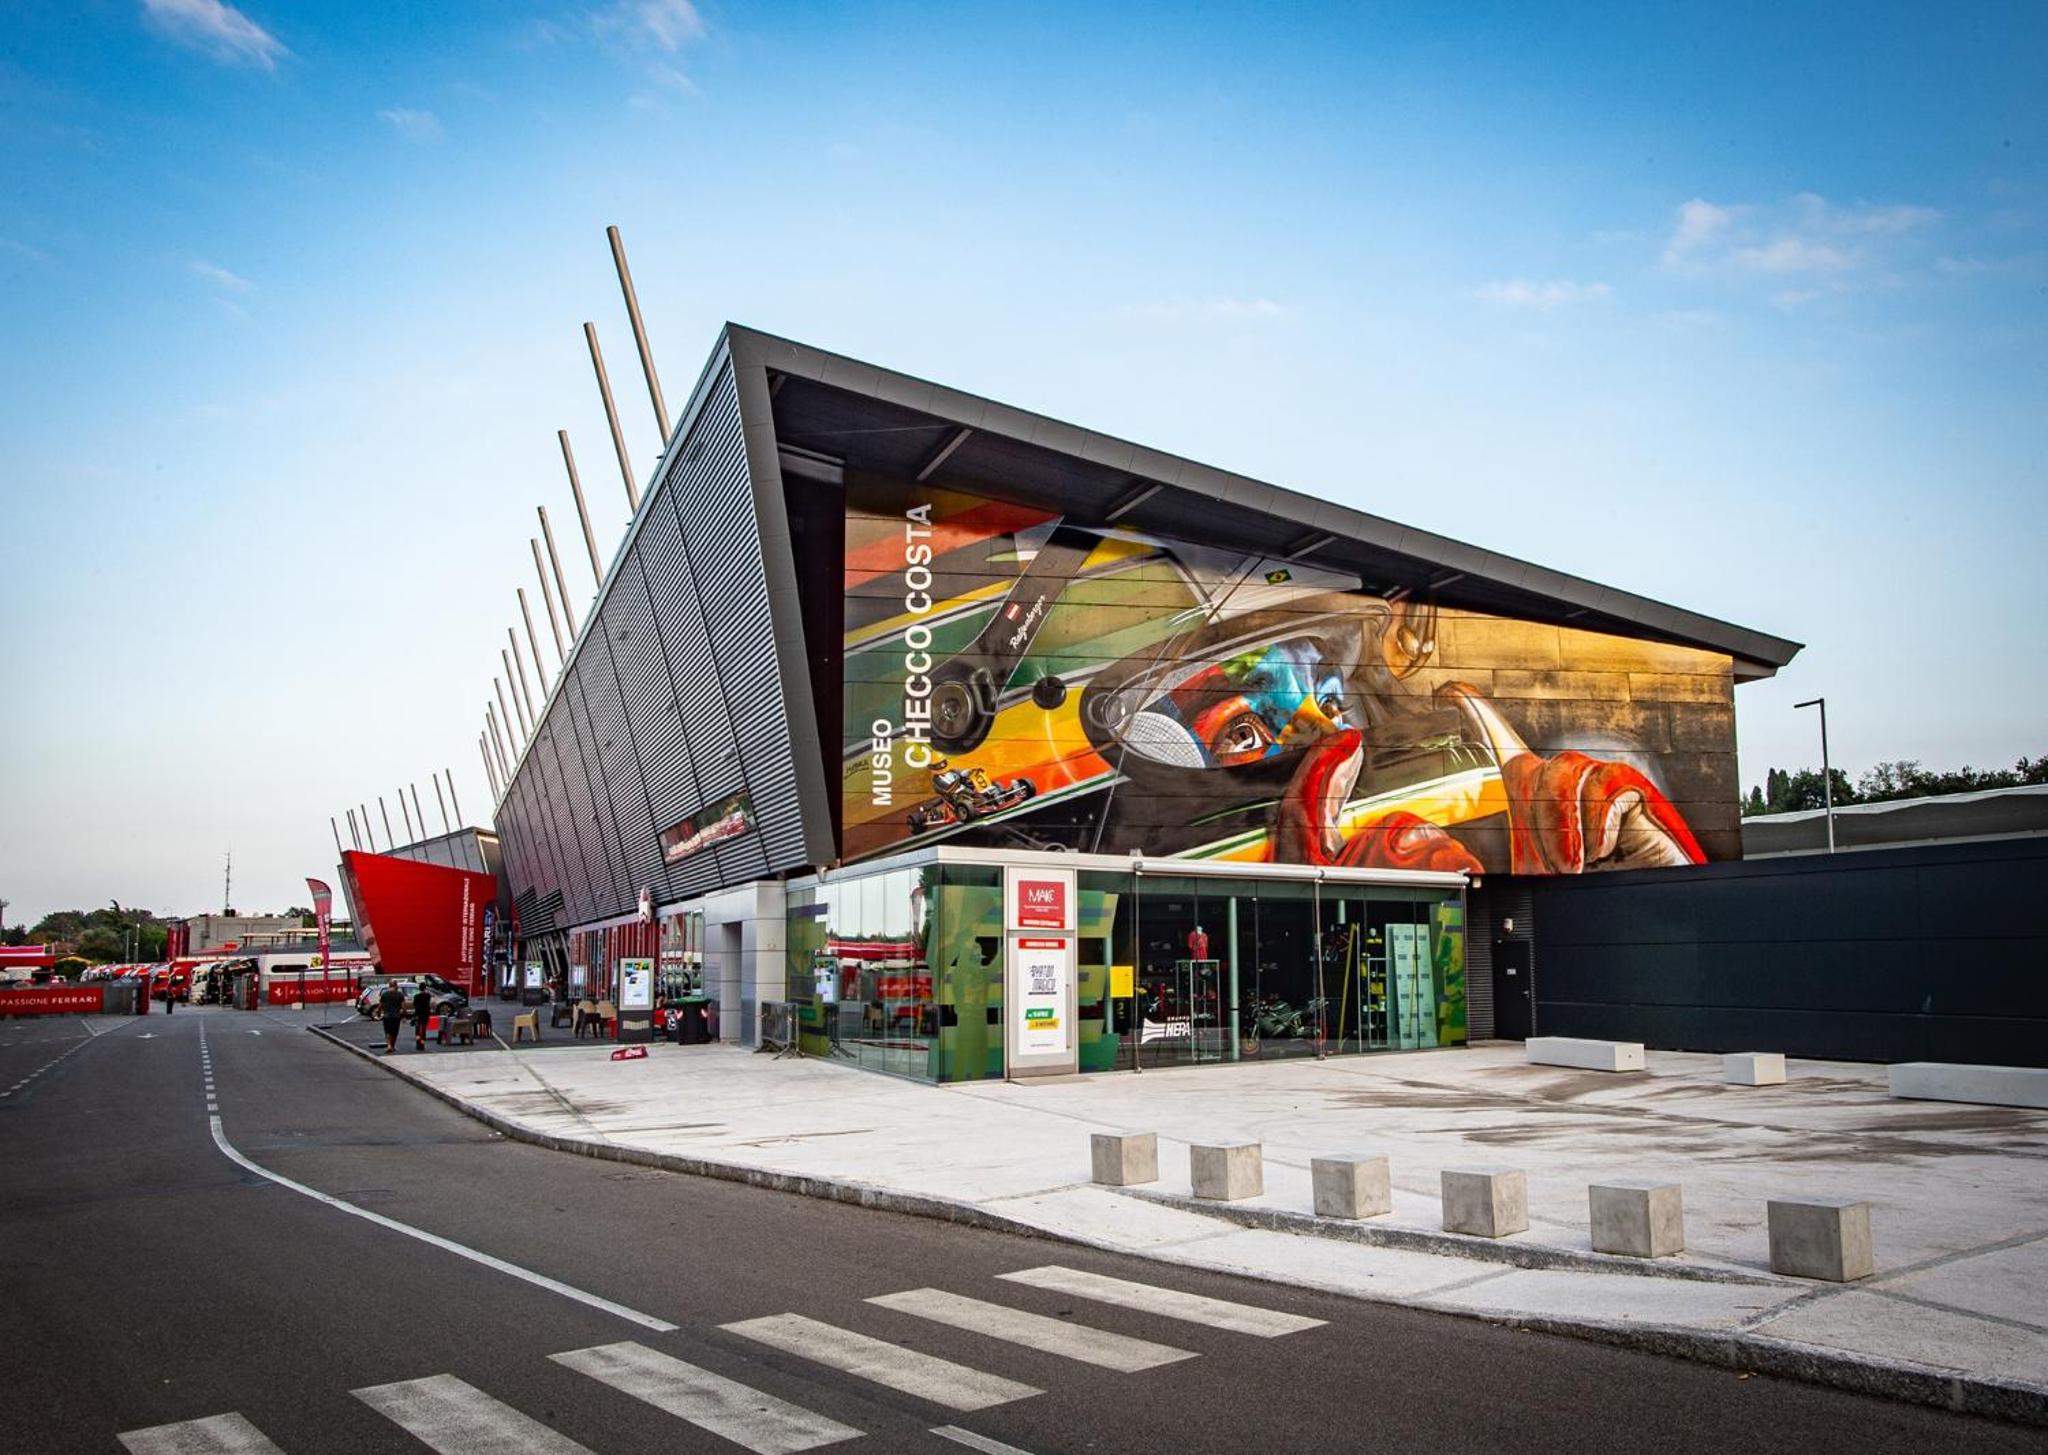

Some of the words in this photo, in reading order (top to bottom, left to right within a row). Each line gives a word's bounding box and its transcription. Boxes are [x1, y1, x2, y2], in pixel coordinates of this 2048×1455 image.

[905, 503, 931, 614] COSTA
[905, 625, 931, 768] CHECCO
[872, 719, 892, 806] MUSEO
[0, 997, 48, 1006] PASSIONE
[51, 996, 97, 1005] FERRARI
